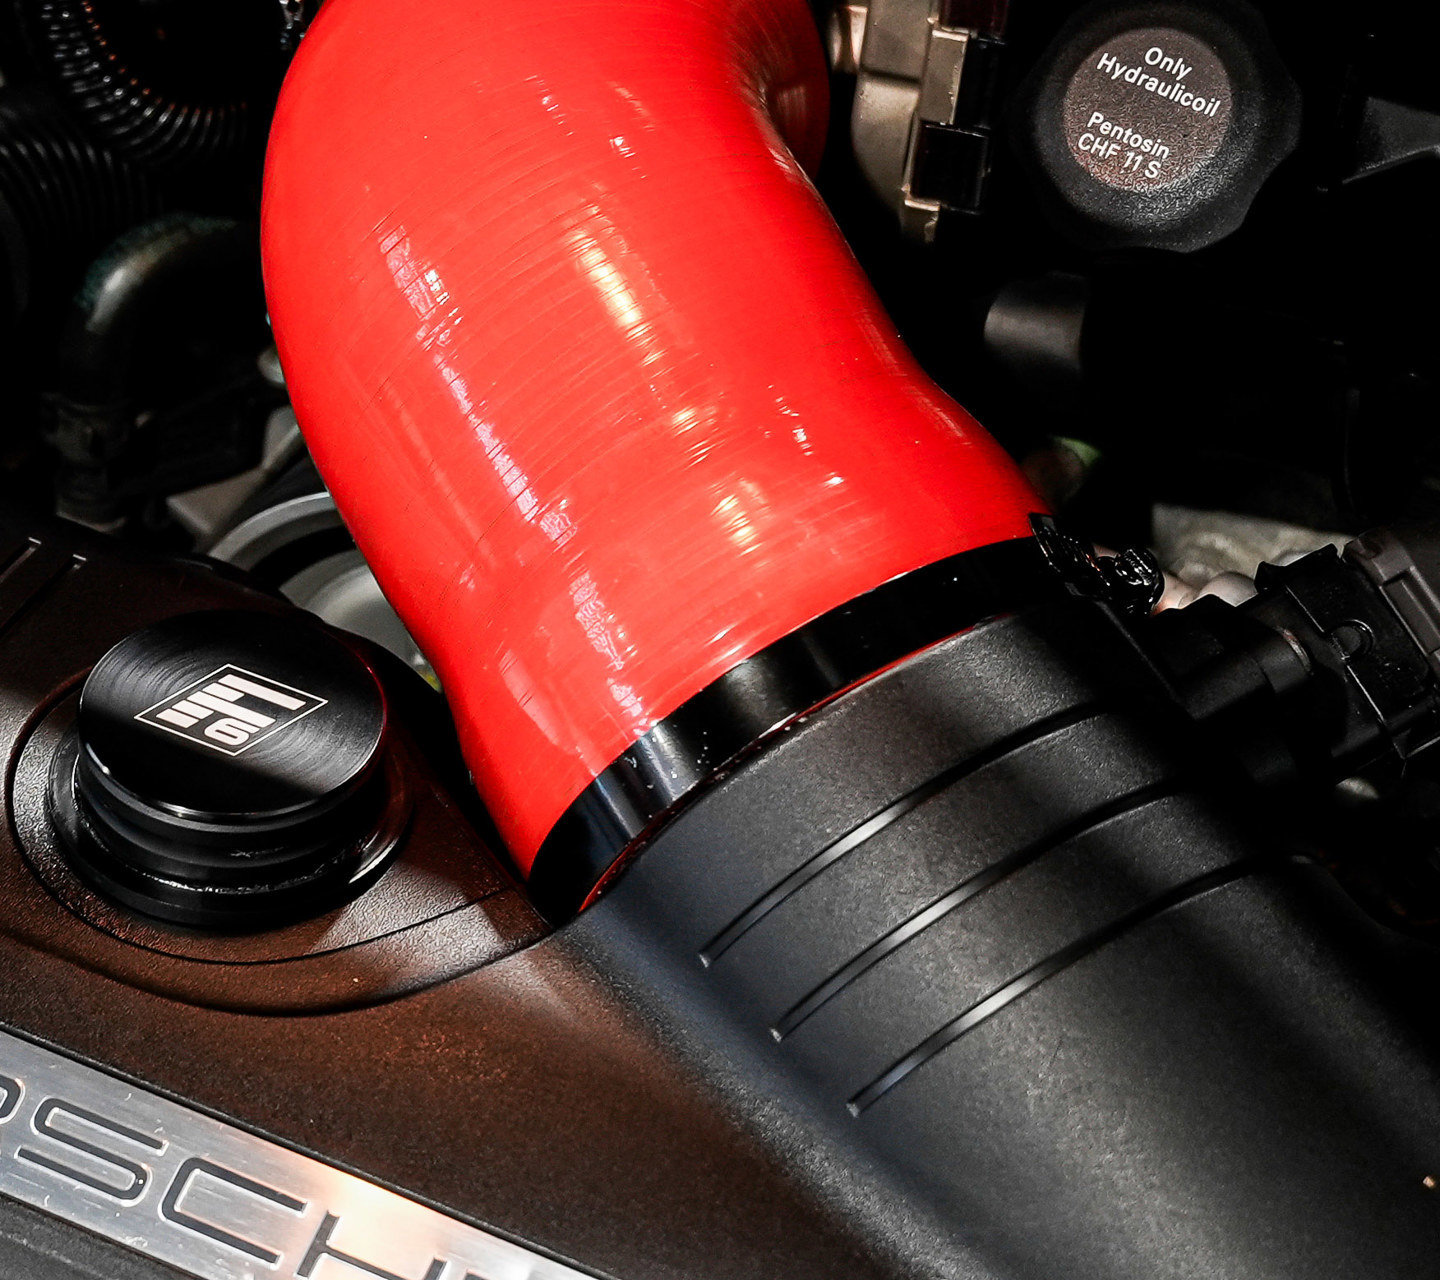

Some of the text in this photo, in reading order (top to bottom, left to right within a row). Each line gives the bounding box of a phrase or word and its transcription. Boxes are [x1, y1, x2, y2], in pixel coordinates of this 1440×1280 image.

[1096, 53, 1221, 118] Hydraulicoil
[1144, 47, 1193, 81] Only
[1077, 132, 1162, 179] CHF 11 S
[1086, 112, 1170, 160] Pentosin
